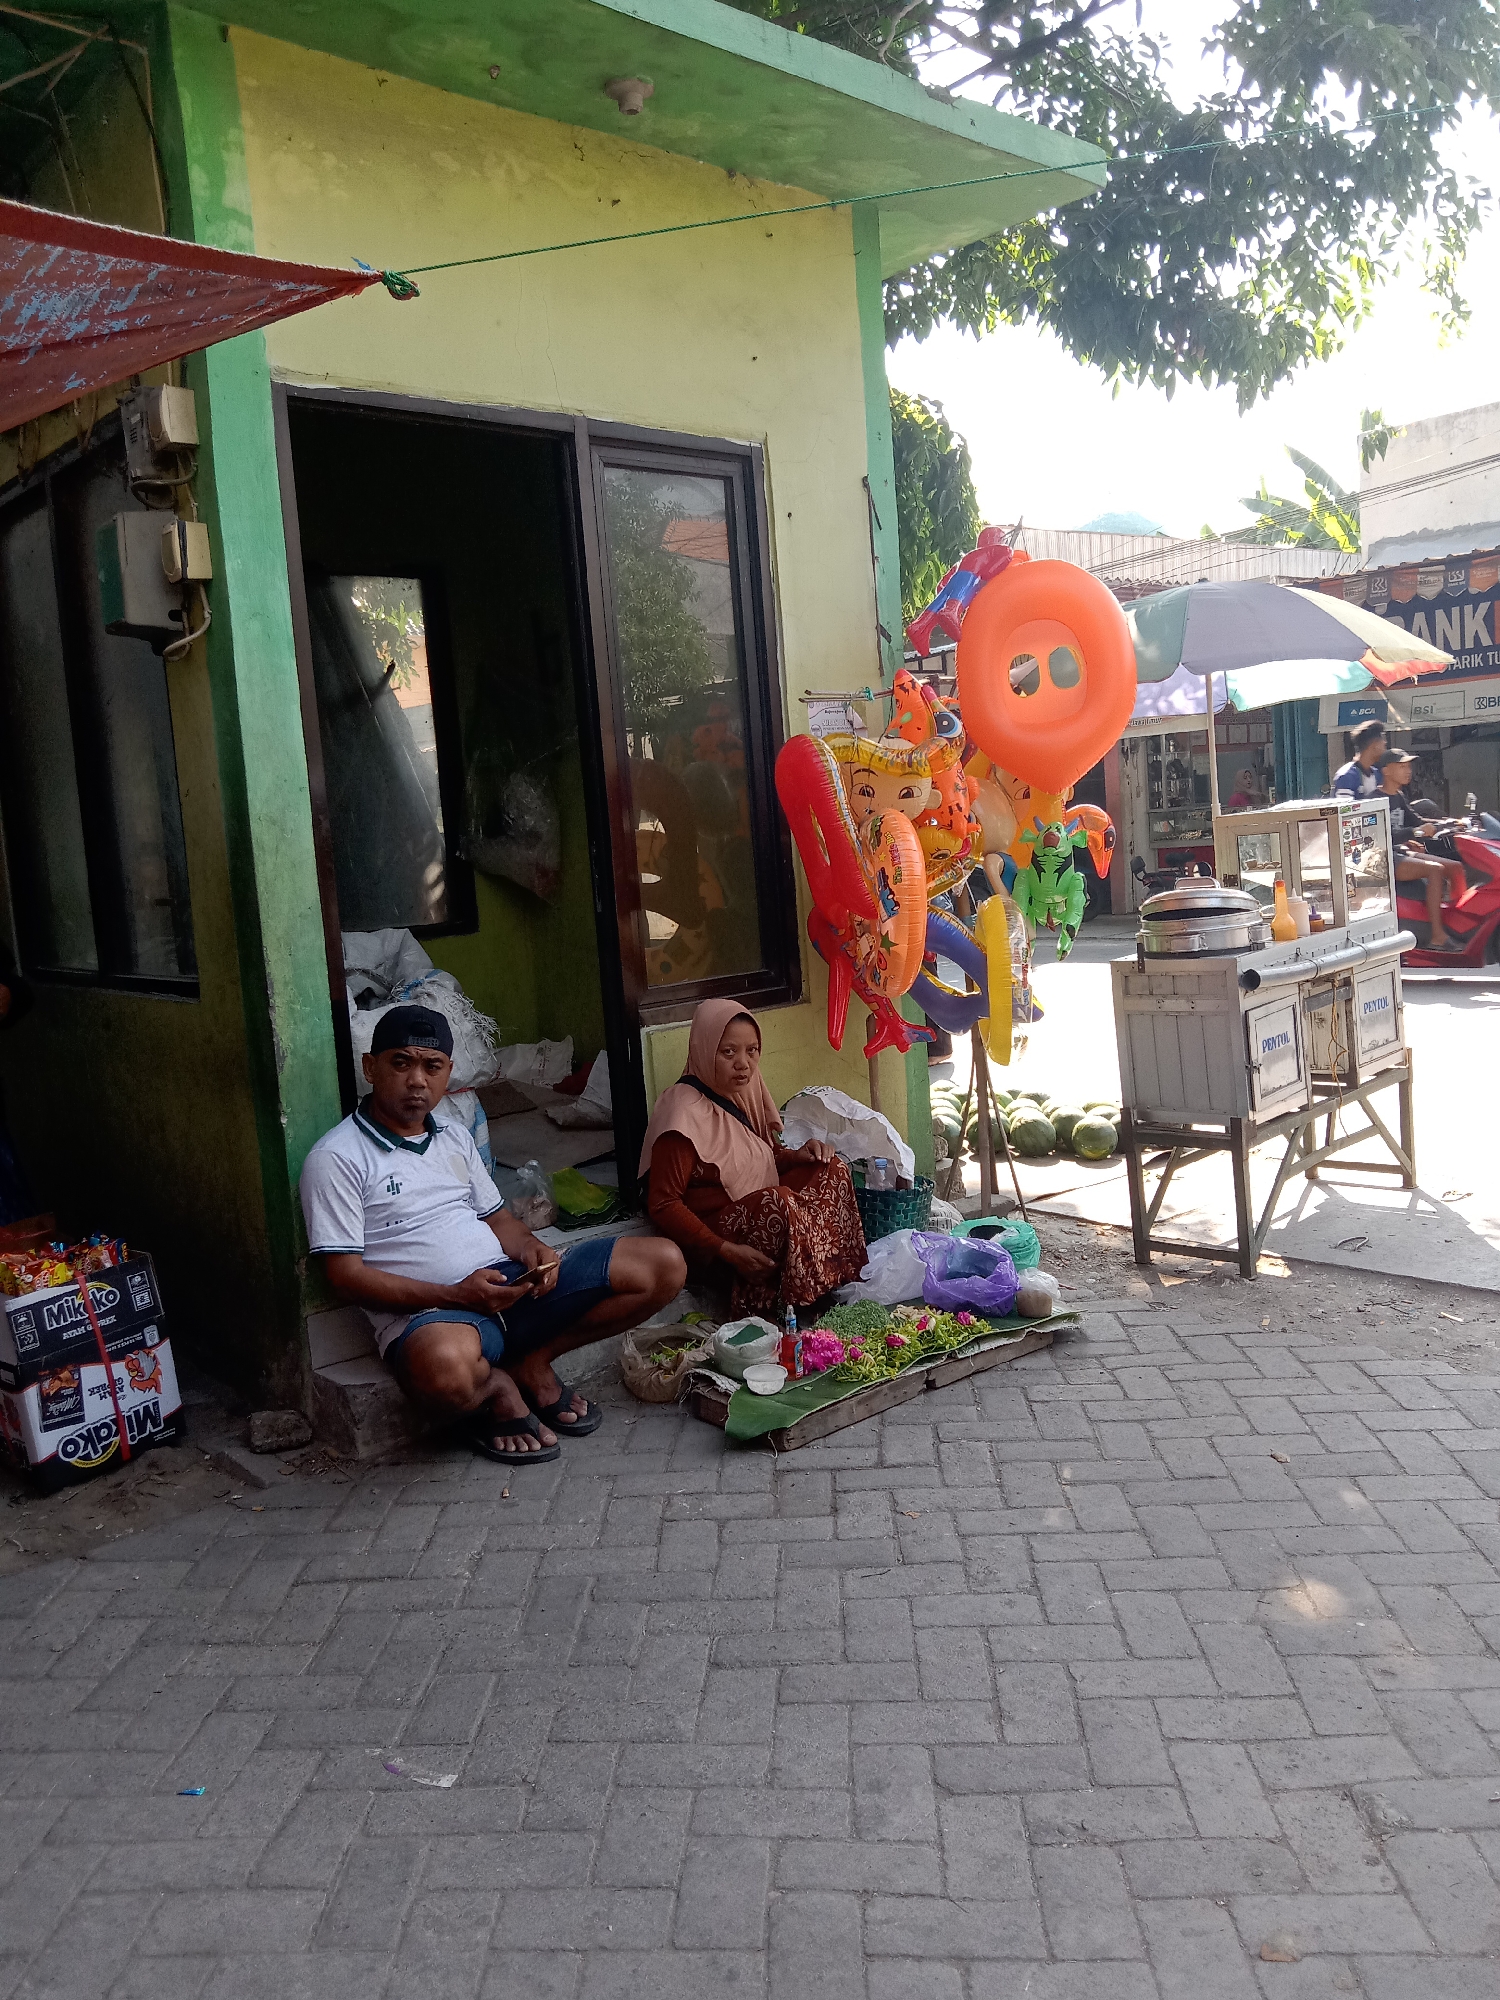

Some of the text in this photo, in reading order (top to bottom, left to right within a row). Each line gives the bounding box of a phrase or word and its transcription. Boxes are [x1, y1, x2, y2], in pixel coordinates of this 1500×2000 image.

[1358, 707, 1376, 716] BCA
[1413, 705, 1434, 715] BSI
[1364, 996, 1389, 1014] PENTOL
[1262, 1031, 1290, 1053] PENTOL
[44, 1287, 120, 1330] Mikko
[86, 1314, 118, 1331] GREK
